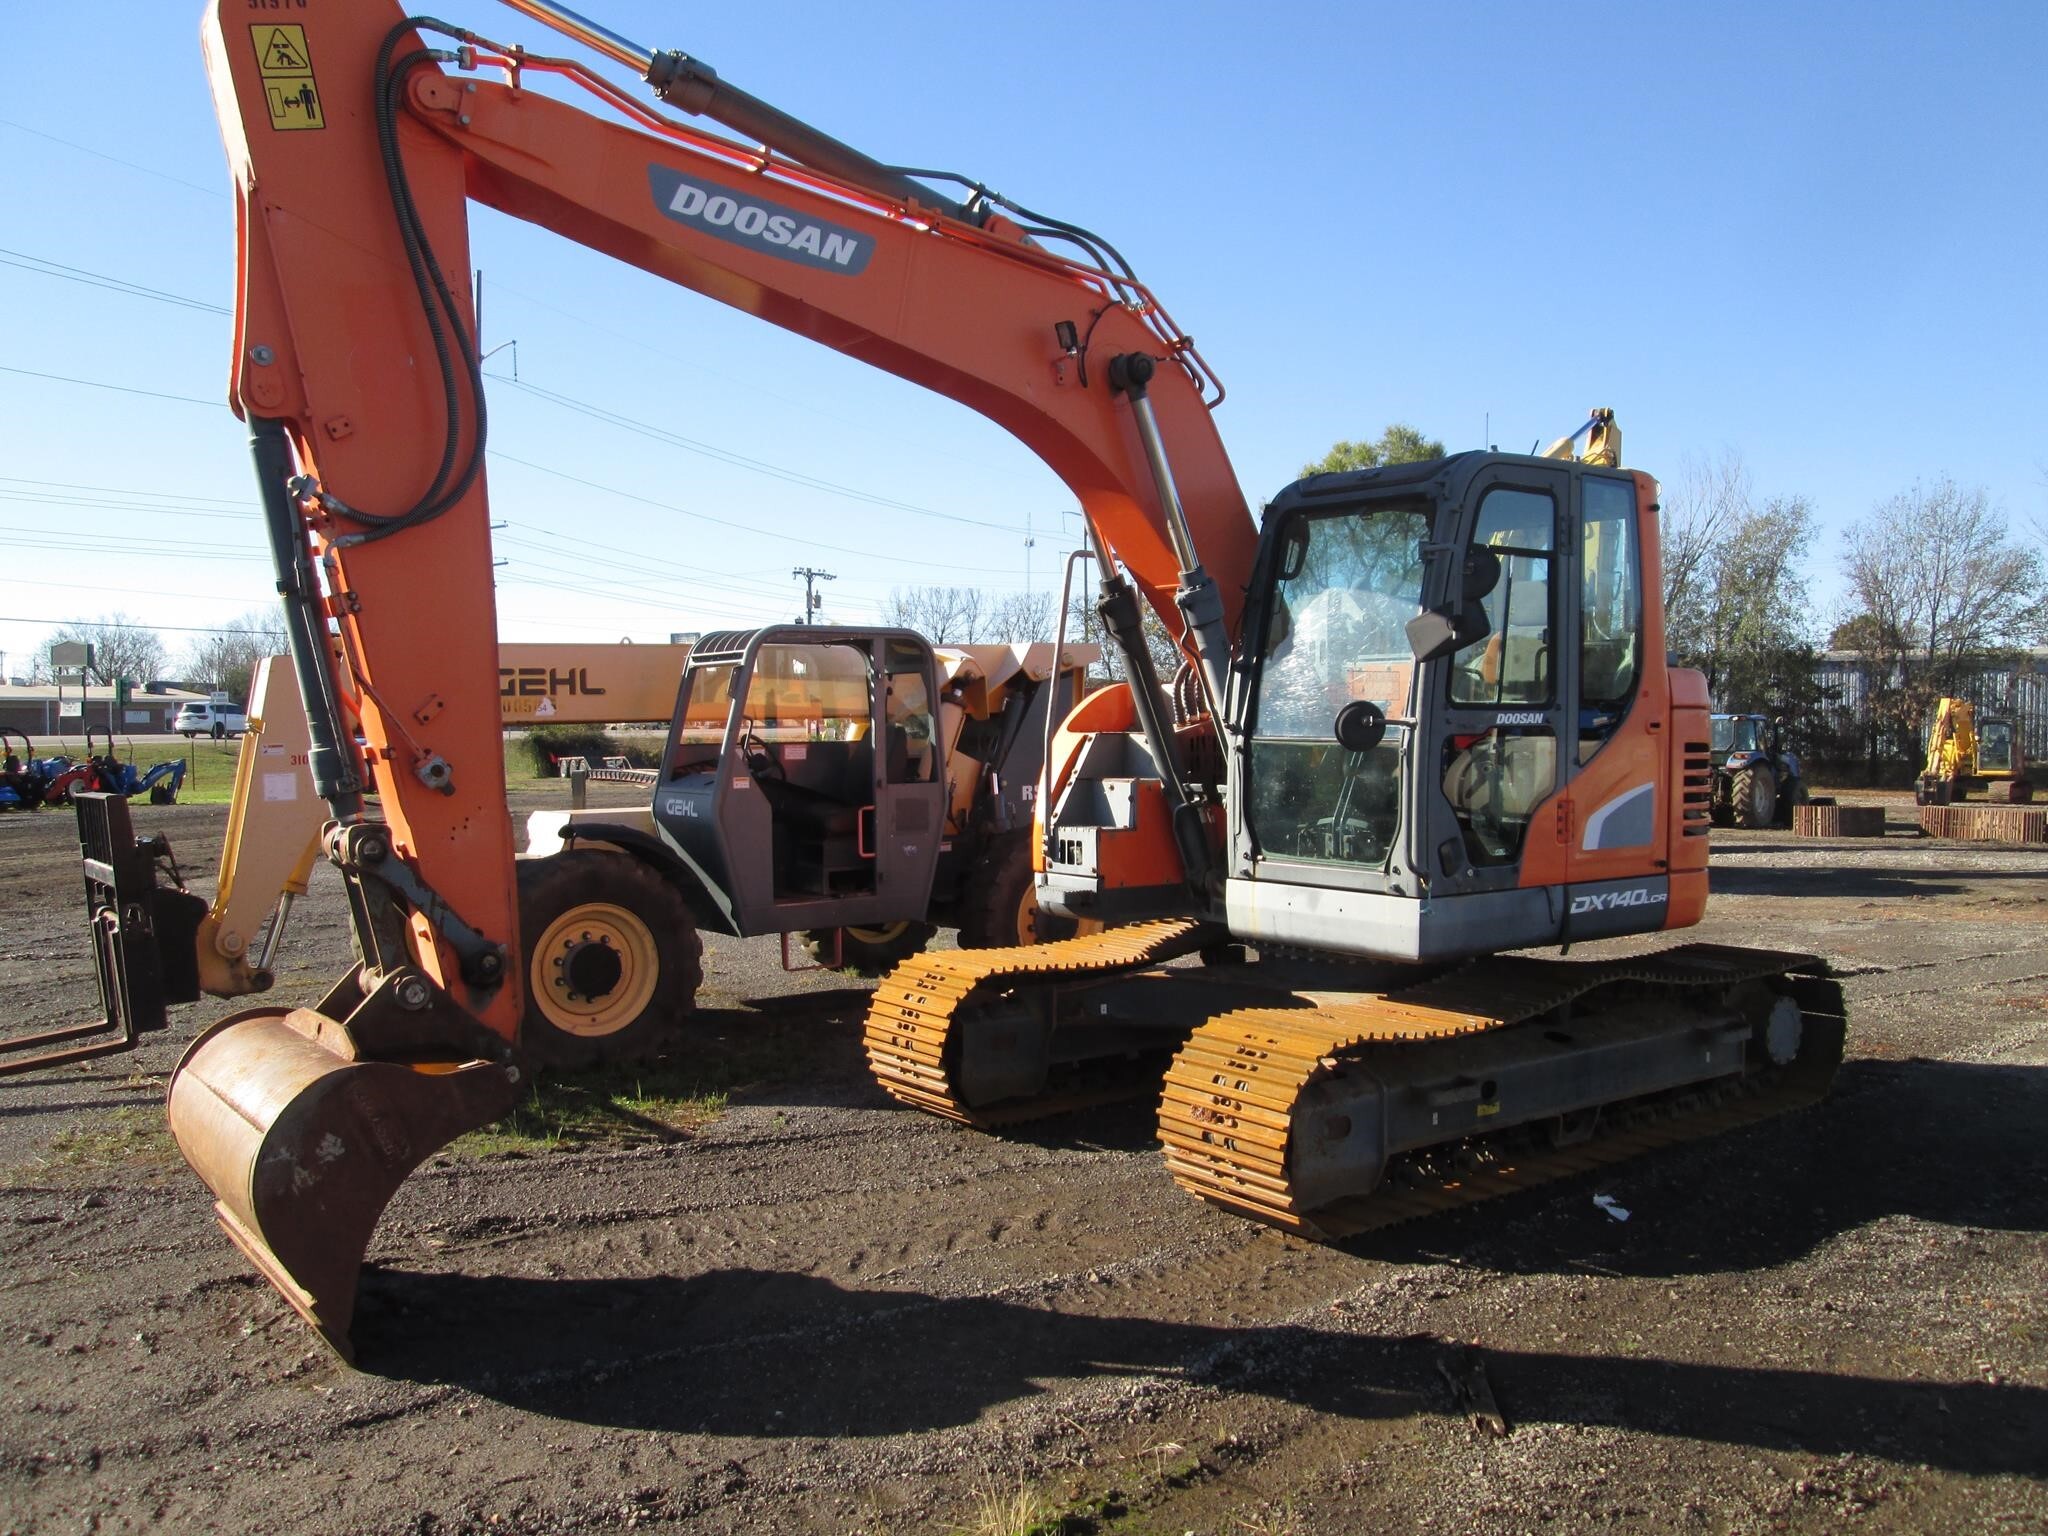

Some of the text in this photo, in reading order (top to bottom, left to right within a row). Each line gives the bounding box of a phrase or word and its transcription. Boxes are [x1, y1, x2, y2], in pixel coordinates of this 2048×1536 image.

[669, 184, 858, 265] DOOSAN
[1496, 713, 1544, 725] DOOSAN
[666, 799, 698, 818] GEHL
